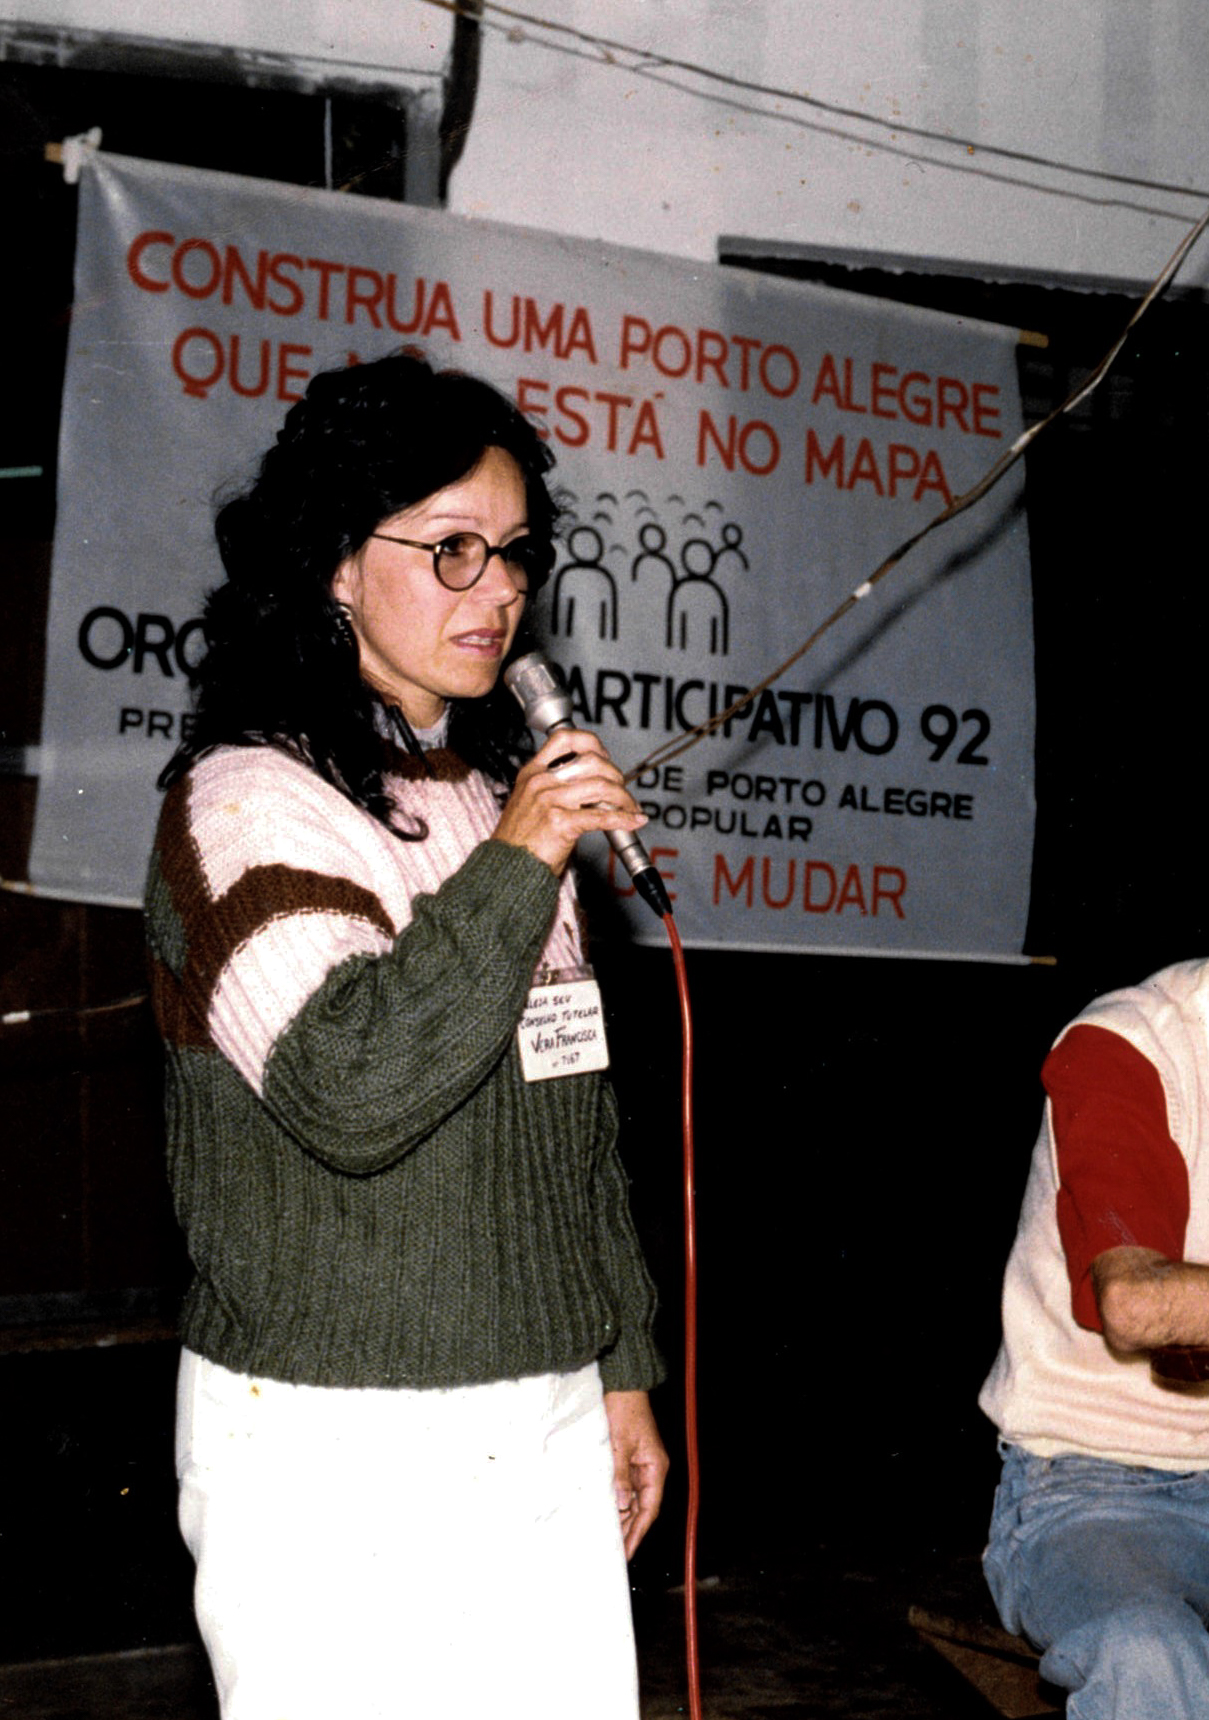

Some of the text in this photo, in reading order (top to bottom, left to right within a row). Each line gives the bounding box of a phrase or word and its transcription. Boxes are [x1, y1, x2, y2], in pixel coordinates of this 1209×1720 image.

[127, 230, 1002, 438] CONSTRUA UMA PORTO ALEGRE
[172, 327, 312, 402] QUE
[516, 378, 665, 460] ESTÁ
[696, 409, 781, 476] NO
[804, 429, 957, 509] MAPA
[919, 704, 992, 767] 92
[636, 766, 975, 821] DE PORTO ALEGRE
[640, 801, 813, 843] POPULAR
[712, 853, 907, 920] MUDAR
